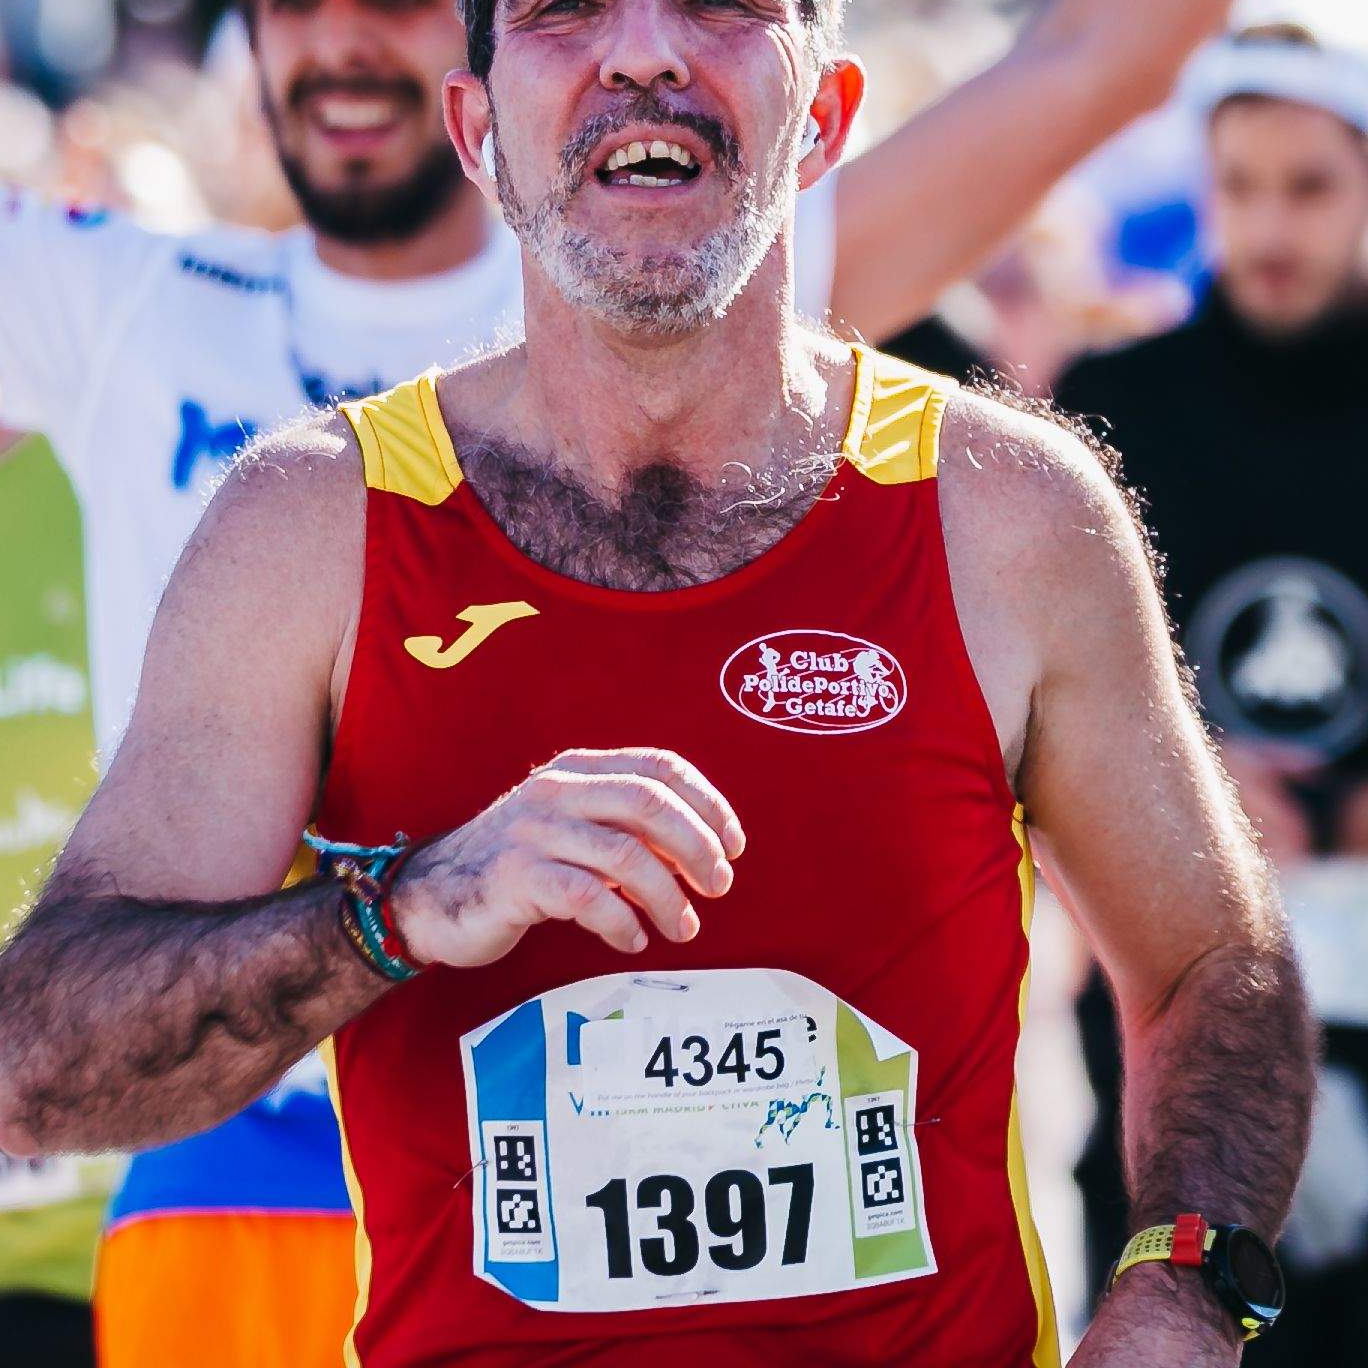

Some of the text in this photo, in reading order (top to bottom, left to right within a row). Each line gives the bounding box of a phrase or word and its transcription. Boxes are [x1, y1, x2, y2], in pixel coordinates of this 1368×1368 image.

[789, 650, 850, 672] Club
[785, 697, 857, 718] Getafe
[644, 1029, 786, 1088] 4345
[585, 1162, 815, 1279] 1397
